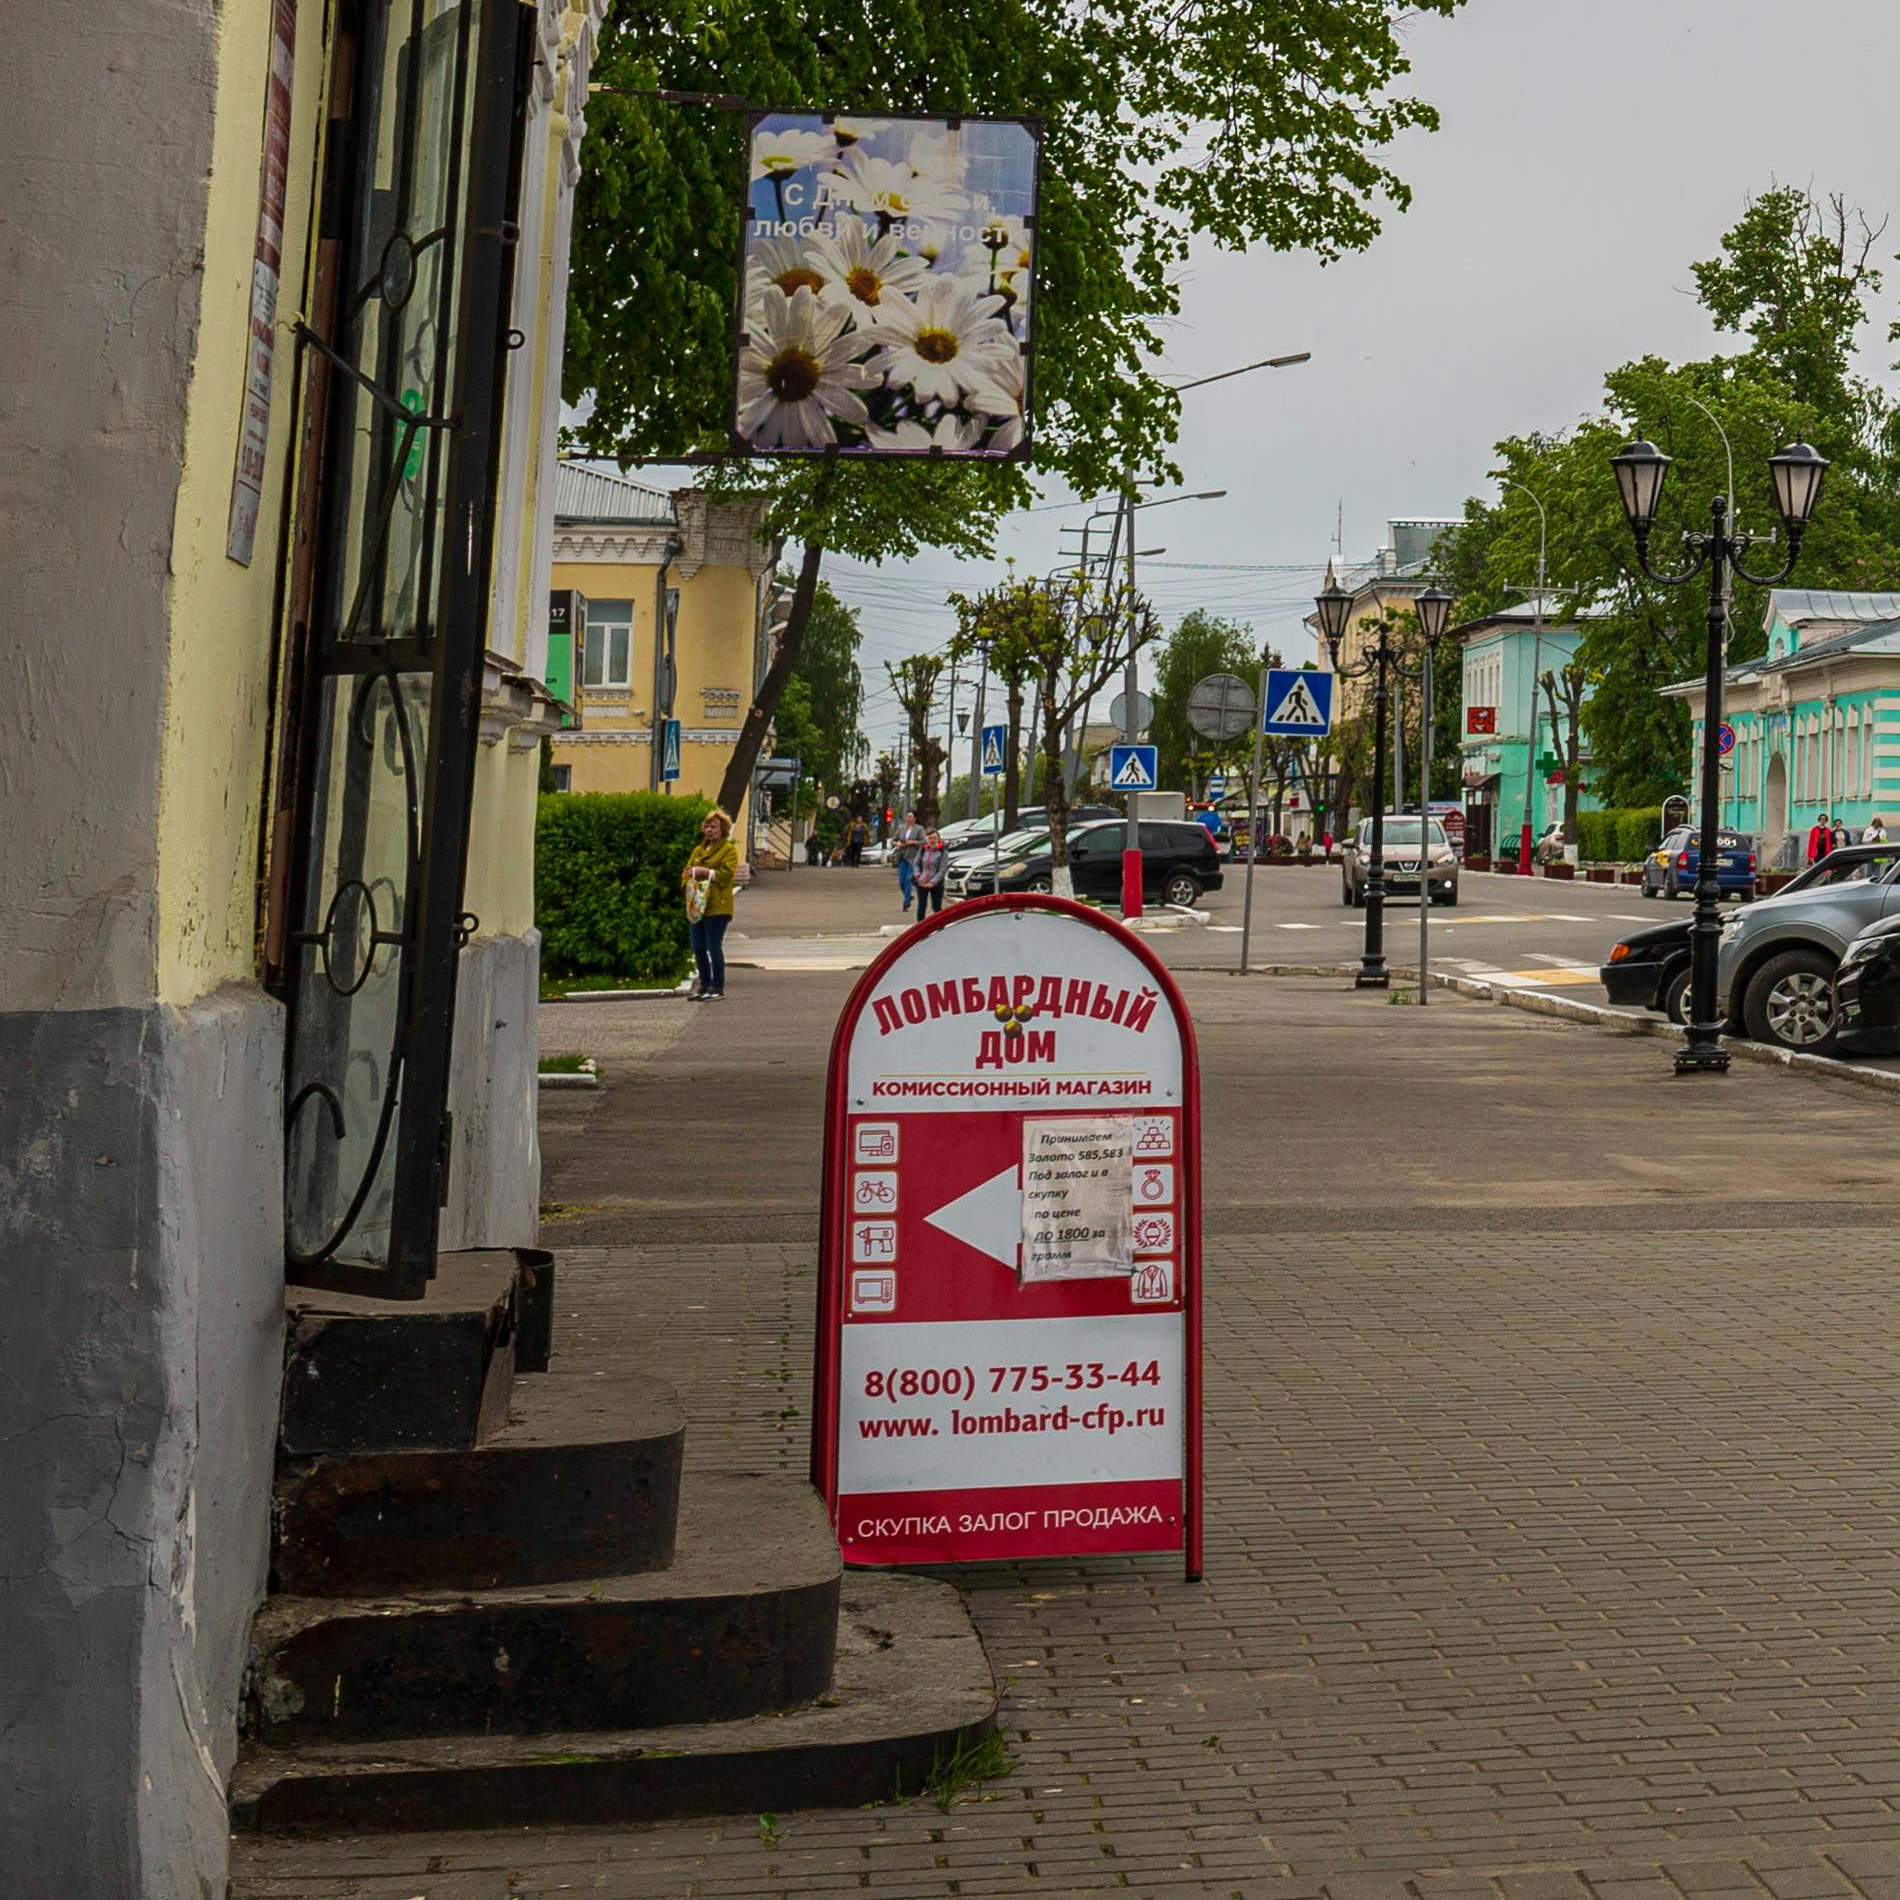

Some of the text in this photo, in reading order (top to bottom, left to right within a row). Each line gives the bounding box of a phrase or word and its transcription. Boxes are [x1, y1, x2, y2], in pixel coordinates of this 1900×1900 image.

[871, 975, 1159, 1036] ЛОМБАРДНЫЙ
[975, 1030, 1056, 1070] ДОМ
[872, 1078, 1152, 1097] КОМИССИОННЫЙ МАГАЗИН
[1040, 1133, 1113, 1146] Принимаем
[1028, 1153, 1075, 1163] Золото
[1028, 1168, 1109, 1181] Под залог и в
[1028, 1190, 1069, 1201] скупку
[1034, 1208, 1081, 1219] по цене
[1057, 1228, 1089, 1241] 1800
[1092, 1230, 1105, 1238] за
[1030, 1252, 1072, 1262] грамм
[864, 1360, 1161, 1404] 8(800) 775-33-44
[858, 1403, 1165, 1439] www. lombard-cfp.ru
[857, 1505, 1163, 1538] СКУПКА ЗАЛОГ ПРОДАЖА
